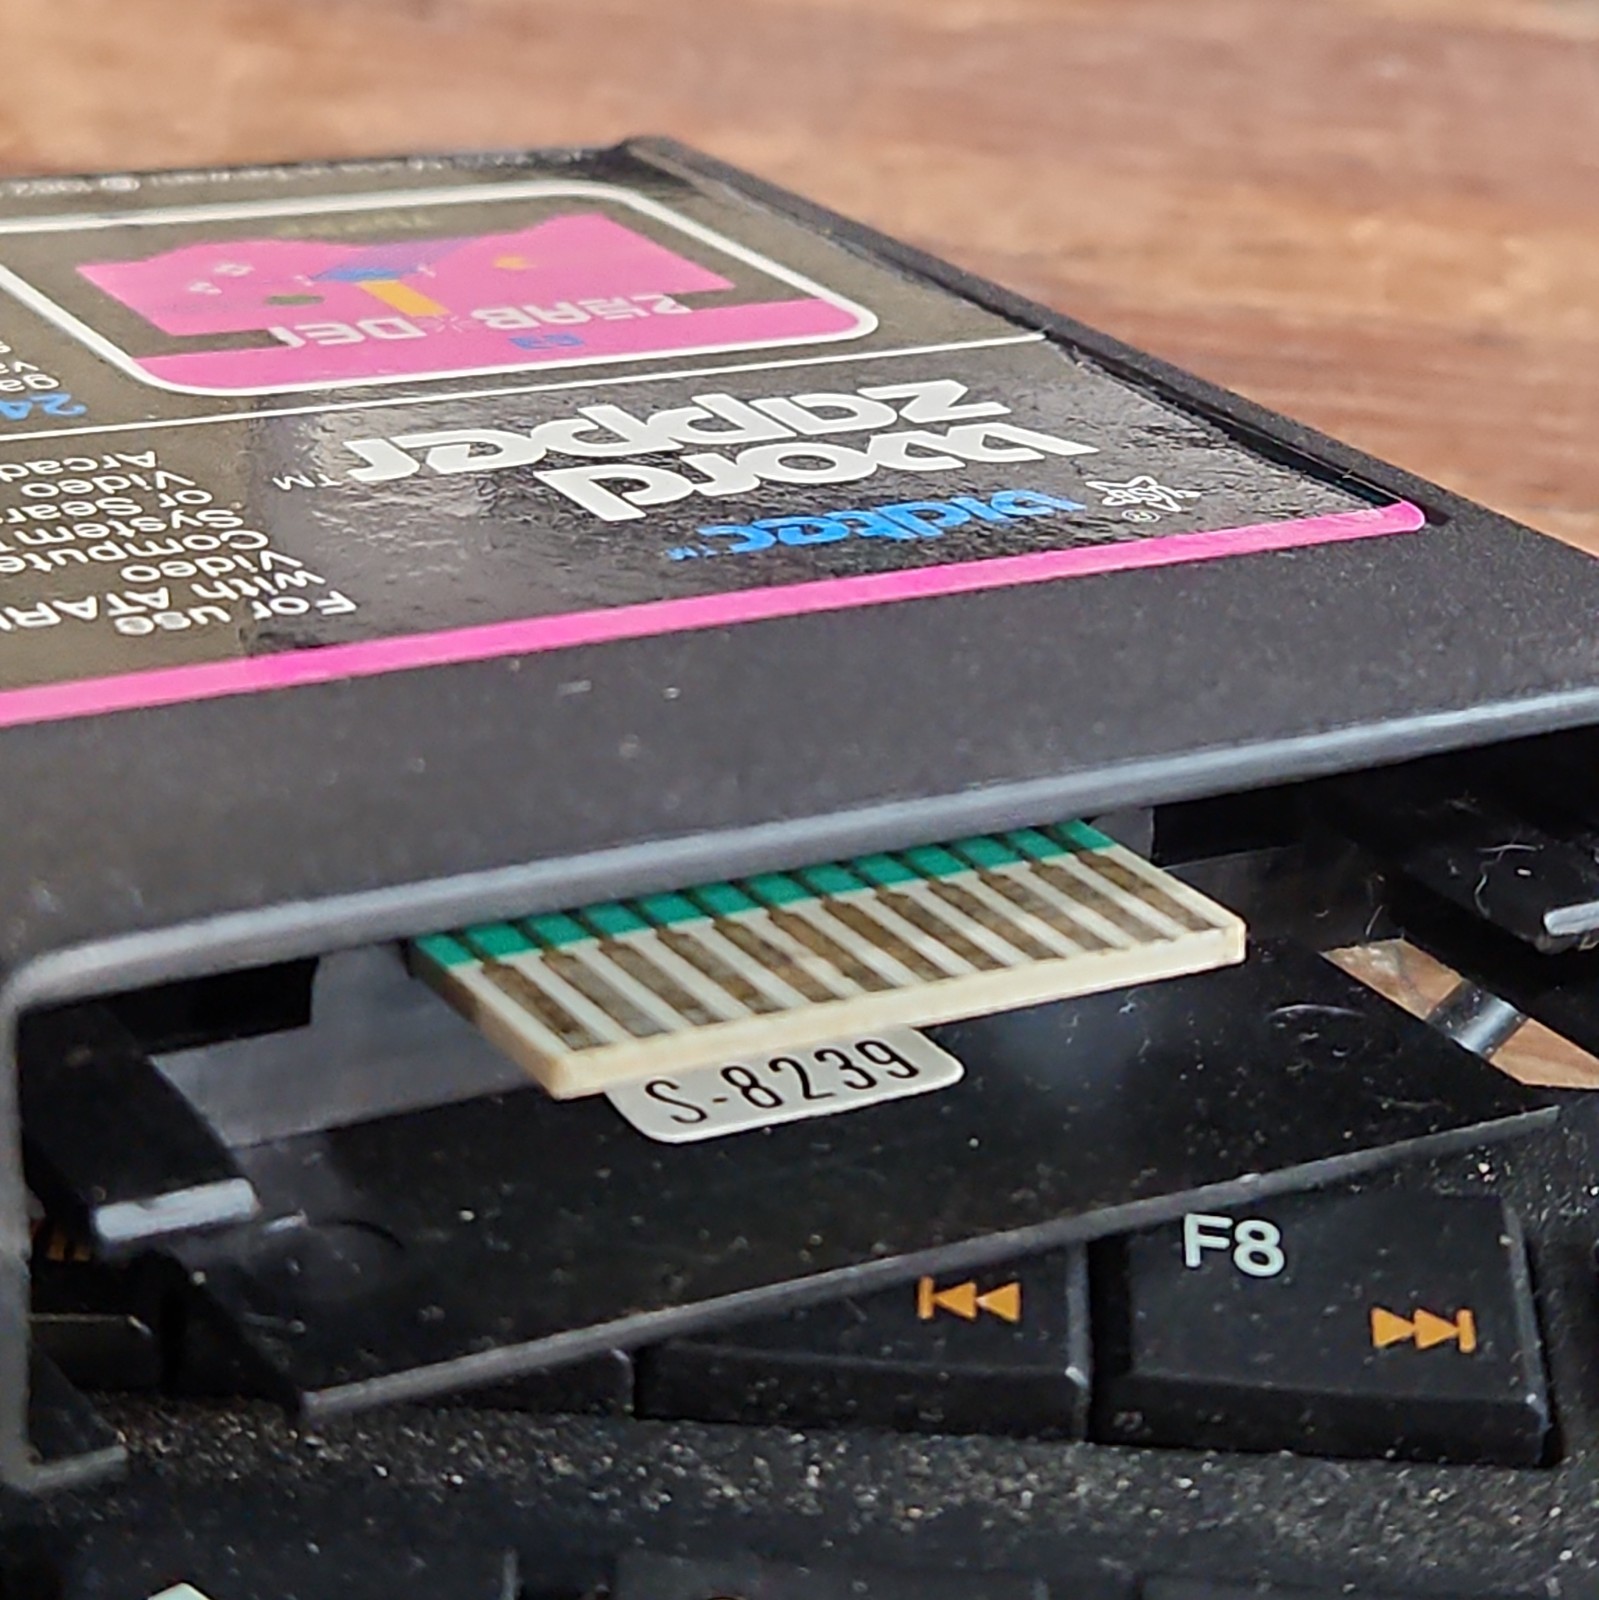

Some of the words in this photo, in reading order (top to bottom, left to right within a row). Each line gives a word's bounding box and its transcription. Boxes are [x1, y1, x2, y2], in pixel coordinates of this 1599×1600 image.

[343, 379, 1012, 482] zapper
[0, 450, 156, 482] Arcad
[20, 470, 196, 498] Video
[157, 489, 213, 508] or
[0, 497, 143, 524] Sear
[14, 508, 244, 545] System
[0, 529, 269, 573] Compute
[120, 550, 303, 582] Video
[190, 570, 326, 600] with
[115, 605, 232, 635] use
[252, 590, 357, 619] For
[644, 1039, 920, 1125] S-8239
[1181, 1213, 1287, 1279] F8
